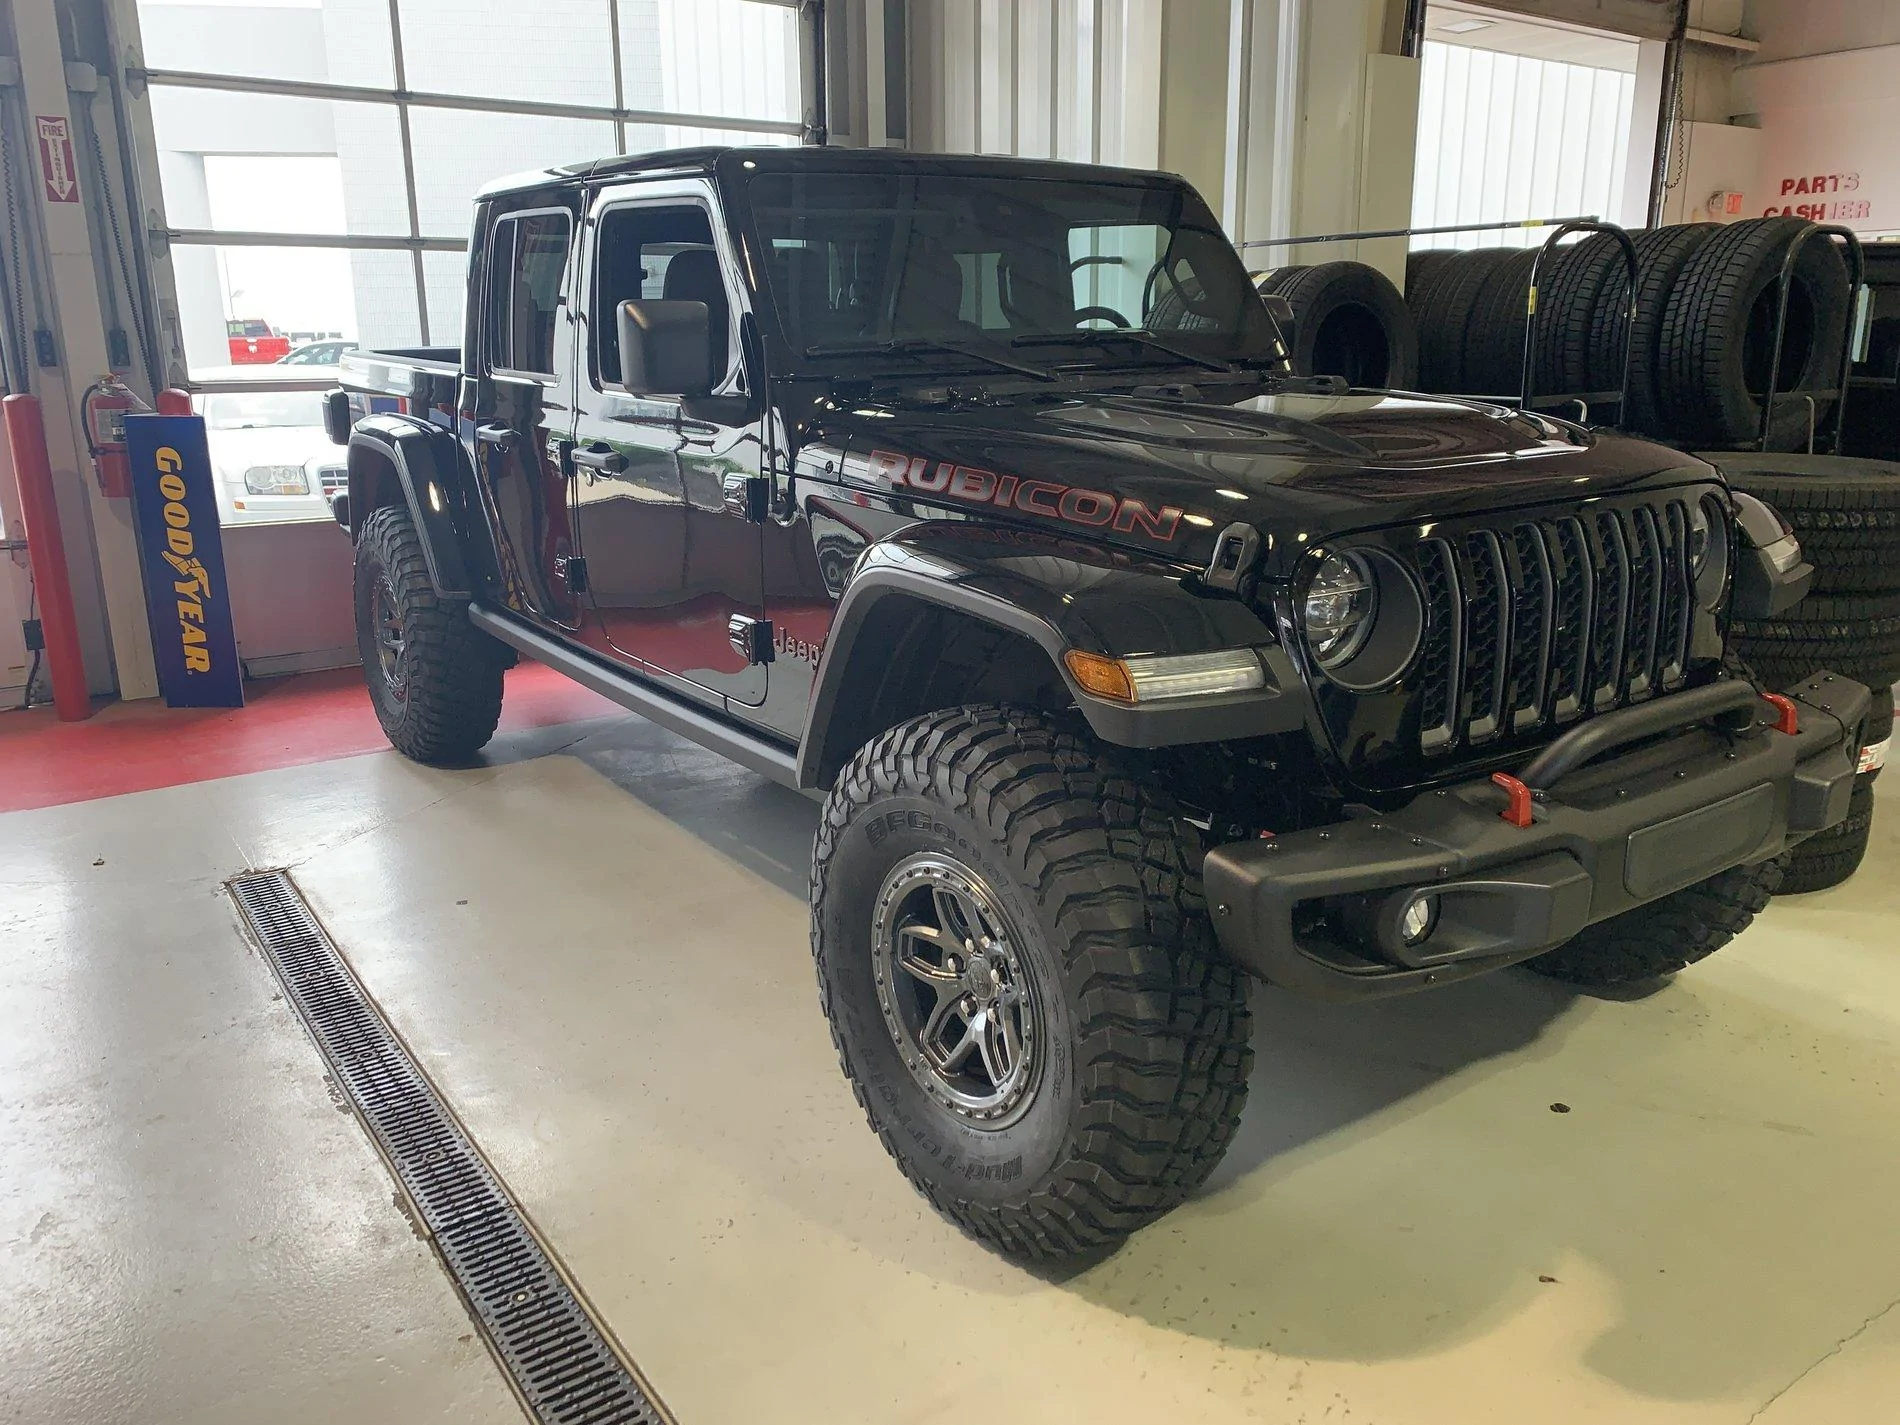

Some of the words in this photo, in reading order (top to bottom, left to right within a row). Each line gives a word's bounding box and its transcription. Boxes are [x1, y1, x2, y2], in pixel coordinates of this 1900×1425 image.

[42, 125, 64, 136] FIRE
[1781, 172, 1860, 196] PARTS
[868, 449, 1184, 541] RUBICON
[156, 447, 211, 674] GOODYEAR
[773, 626, 820, 671] Jeep
